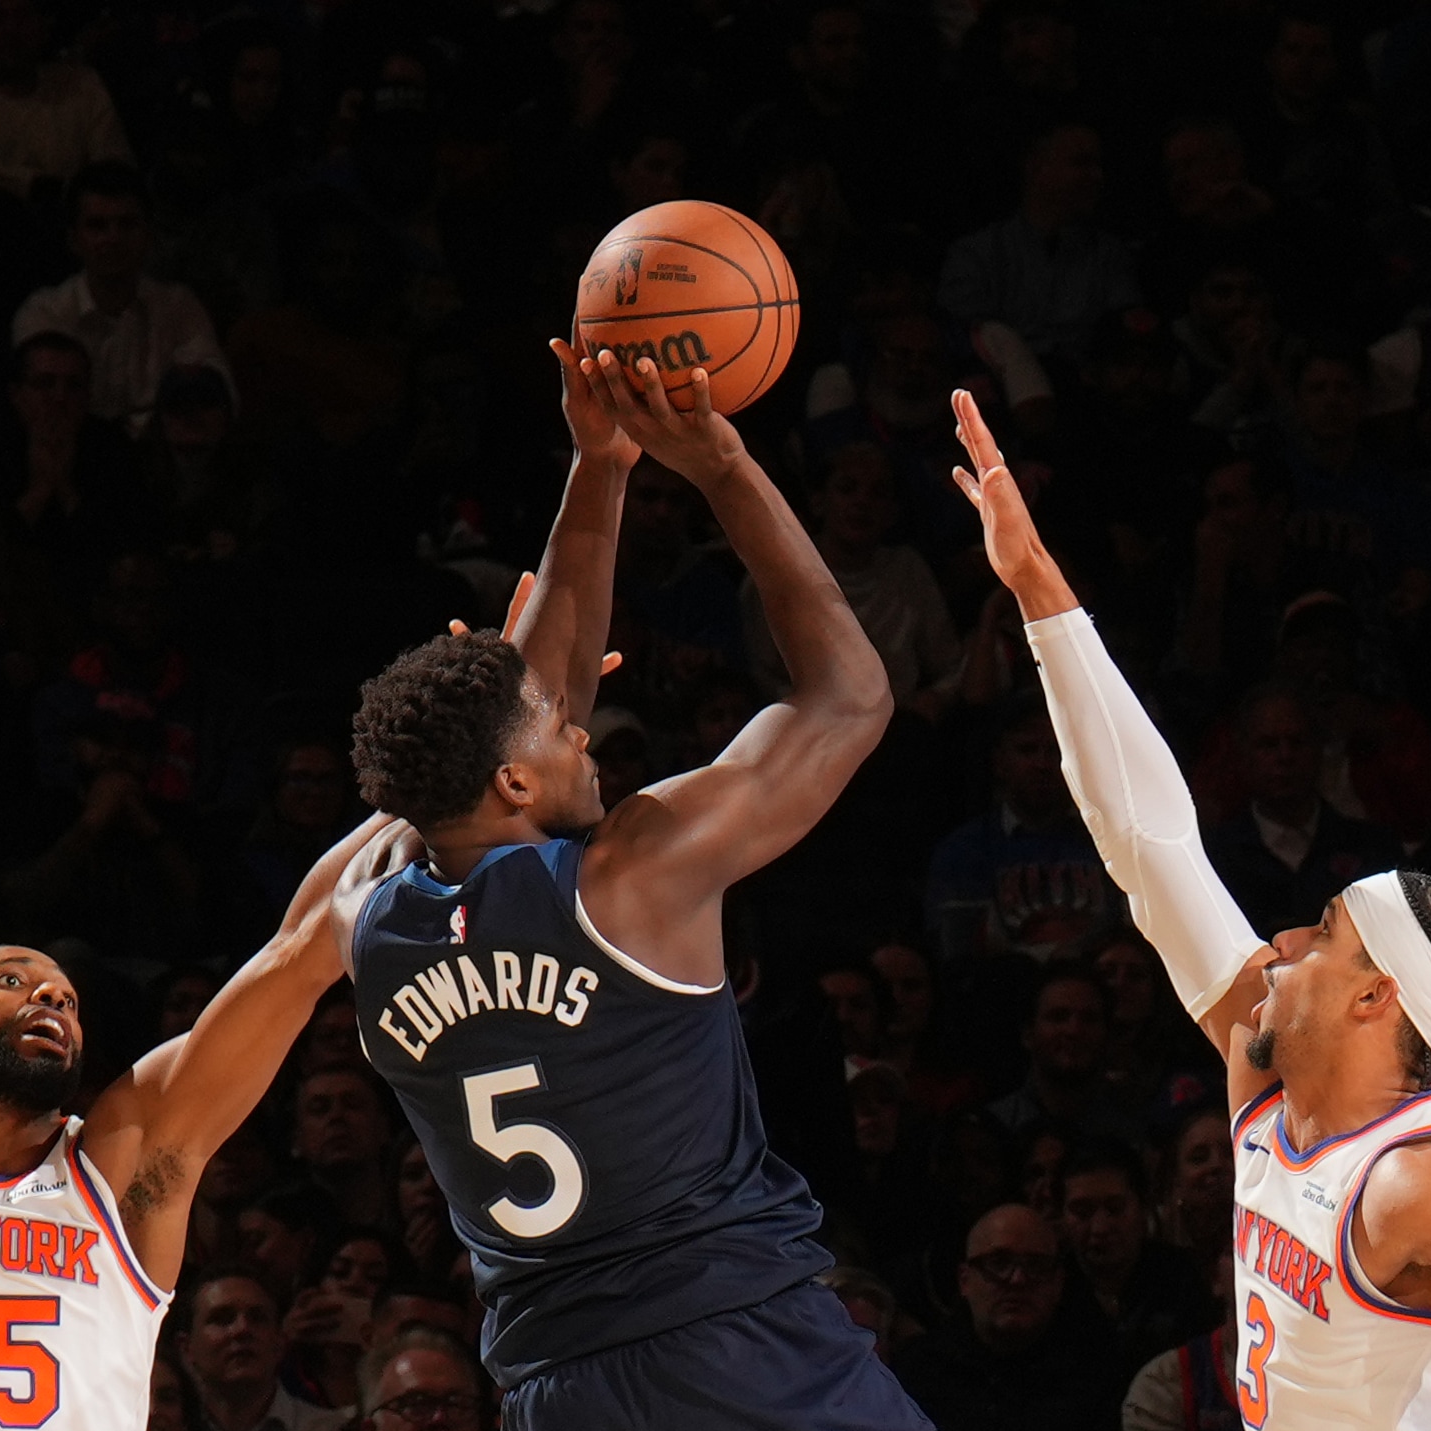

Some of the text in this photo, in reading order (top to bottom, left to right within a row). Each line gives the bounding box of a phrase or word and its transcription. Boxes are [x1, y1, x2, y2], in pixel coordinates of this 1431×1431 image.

[377, 950, 600, 1063] EDWARDS
[459, 1059, 586, 1239] 5
[1254, 1215, 1333, 1324] YORK
[1237, 1290, 1275, 1431] 3
